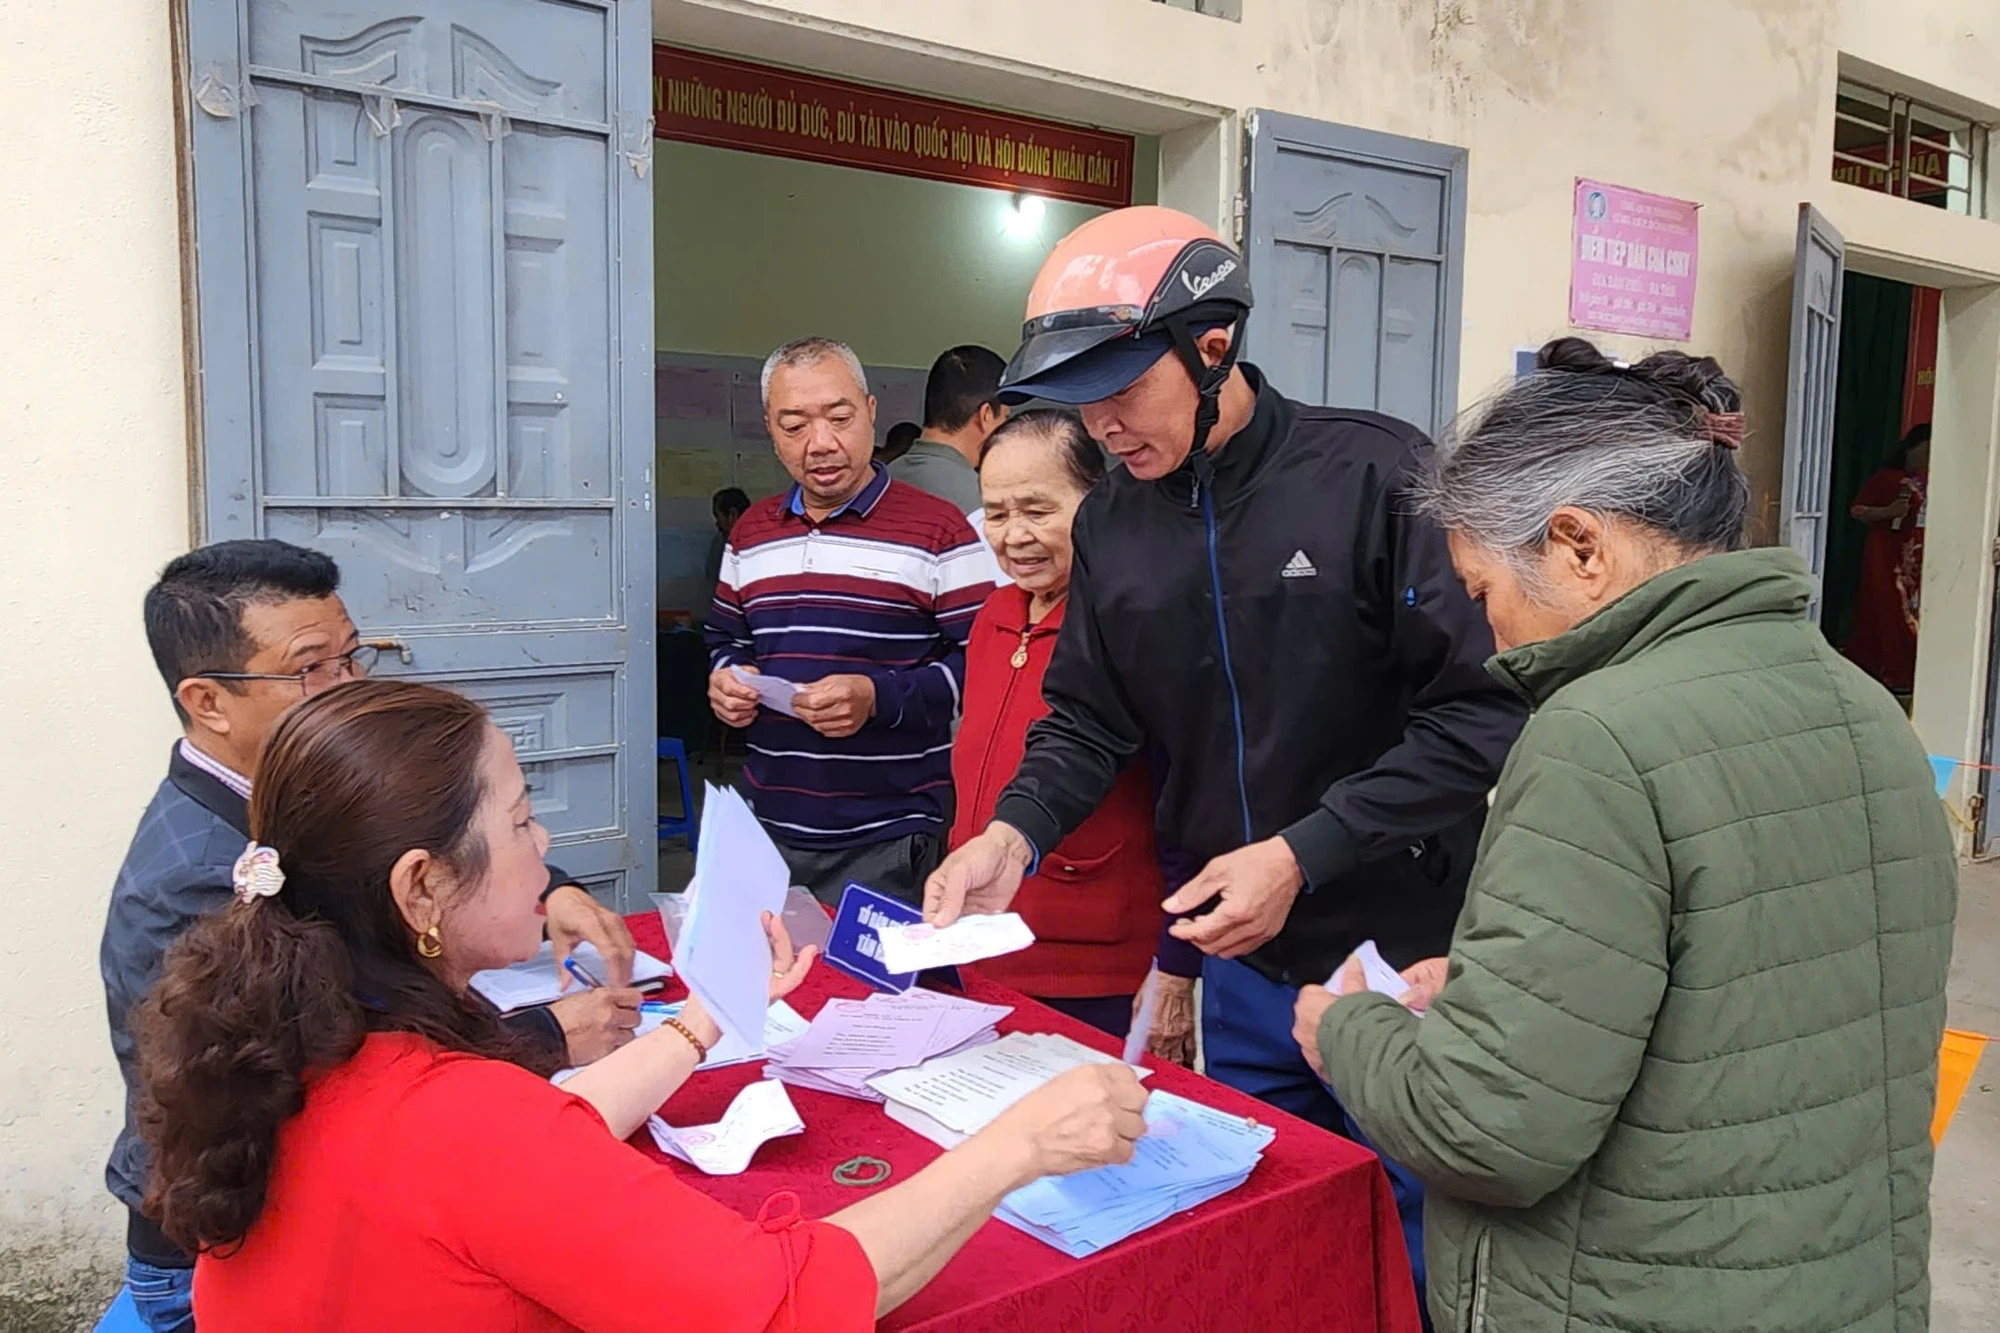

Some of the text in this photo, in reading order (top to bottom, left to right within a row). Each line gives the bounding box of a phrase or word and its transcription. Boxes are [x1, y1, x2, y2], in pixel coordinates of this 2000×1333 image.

[668, 76, 723, 121] NHỮNG
[727, 87, 773, 130] NGƯỜI
[776, 89, 797, 134] ĐỦ
[800, 98, 834, 145] ĐỨC,
[837, 101, 856, 144] ĐỦ
[860, 108, 881, 149] TÀI
[884, 112, 910, 153] VÀO
[914, 116, 948, 160] QUỐC
[952, 126, 973, 170] HỘI
[976, 129, 992, 168] VÀ
[995, 133, 1015, 177] HỘI
[1018, 134, 1050, 177] ĐỒNG
[1053, 145, 1085, 183] NHÂN
[1087, 150, 1111, 187] DÂN
[1181, 259, 1238, 301] Vespa
